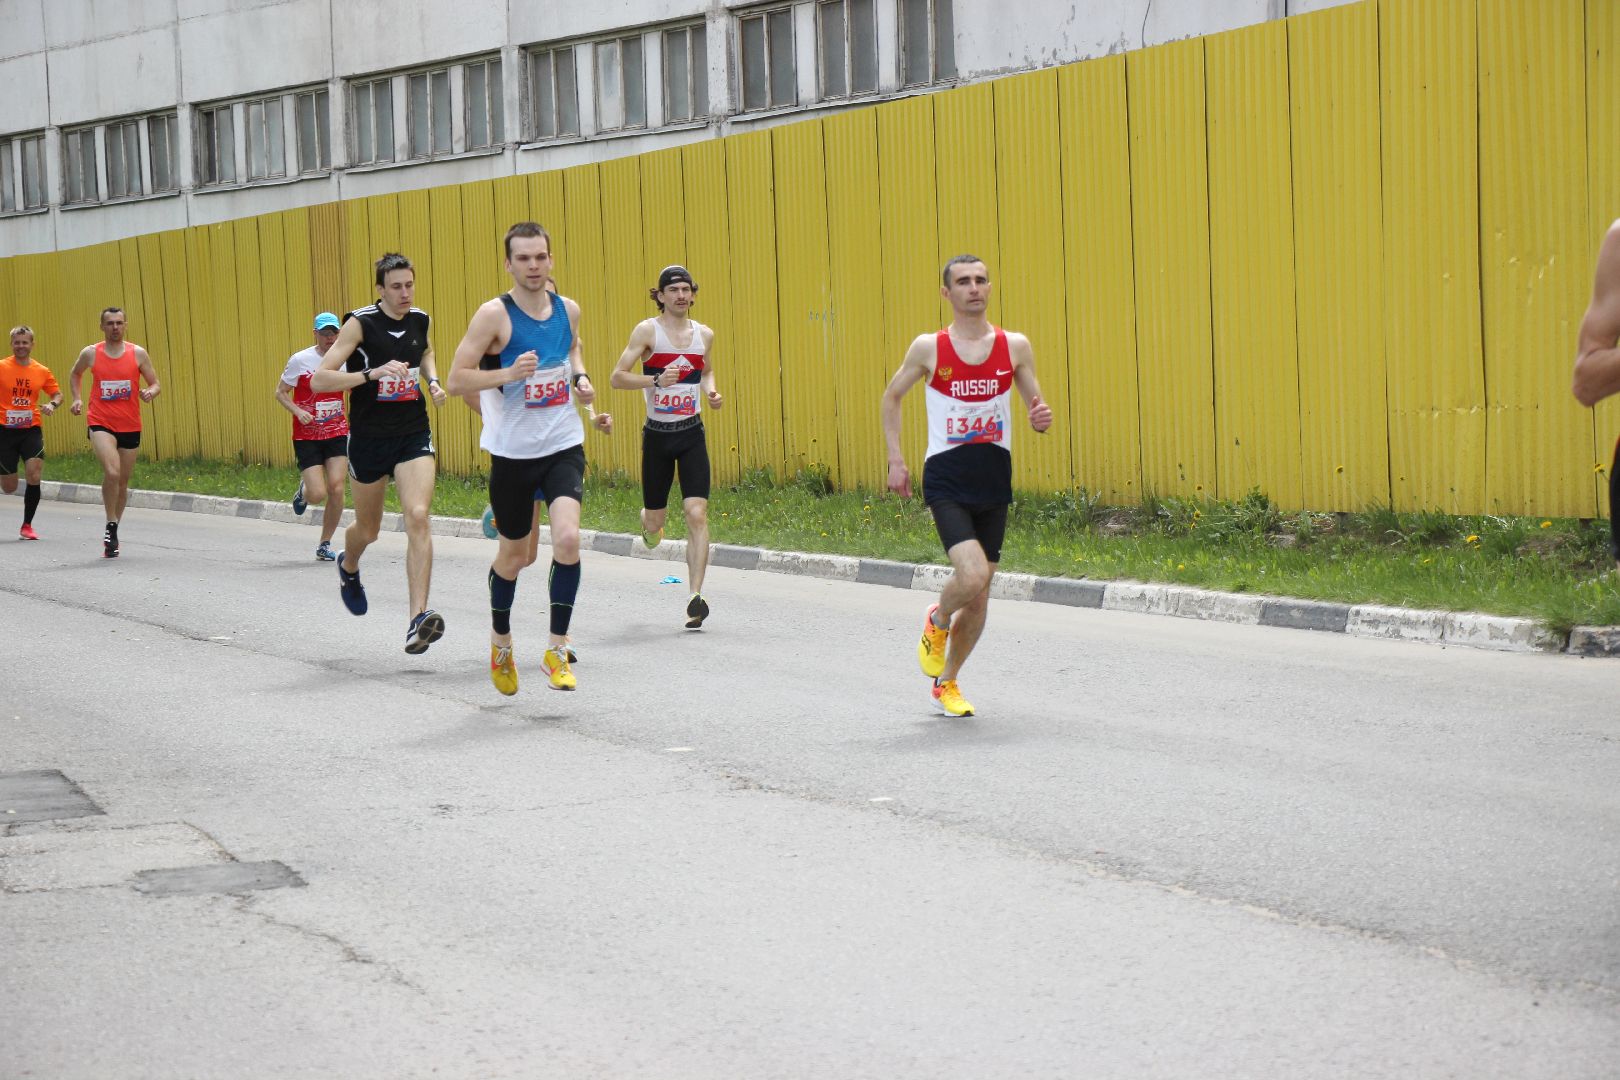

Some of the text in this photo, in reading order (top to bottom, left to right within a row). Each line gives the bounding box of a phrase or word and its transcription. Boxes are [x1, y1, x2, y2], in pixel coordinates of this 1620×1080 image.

[15, 377, 31, 388] WE
[386, 380, 415, 395] 382
[533, 379, 566, 399] 350
[950, 379, 999, 397] RUSSIA
[12, 387, 32, 397] RUN
[105, 387, 128, 397] 349
[660, 394, 693, 408] 400
[648, 418, 675, 431] NIKE
[957, 415, 997, 434] 346
